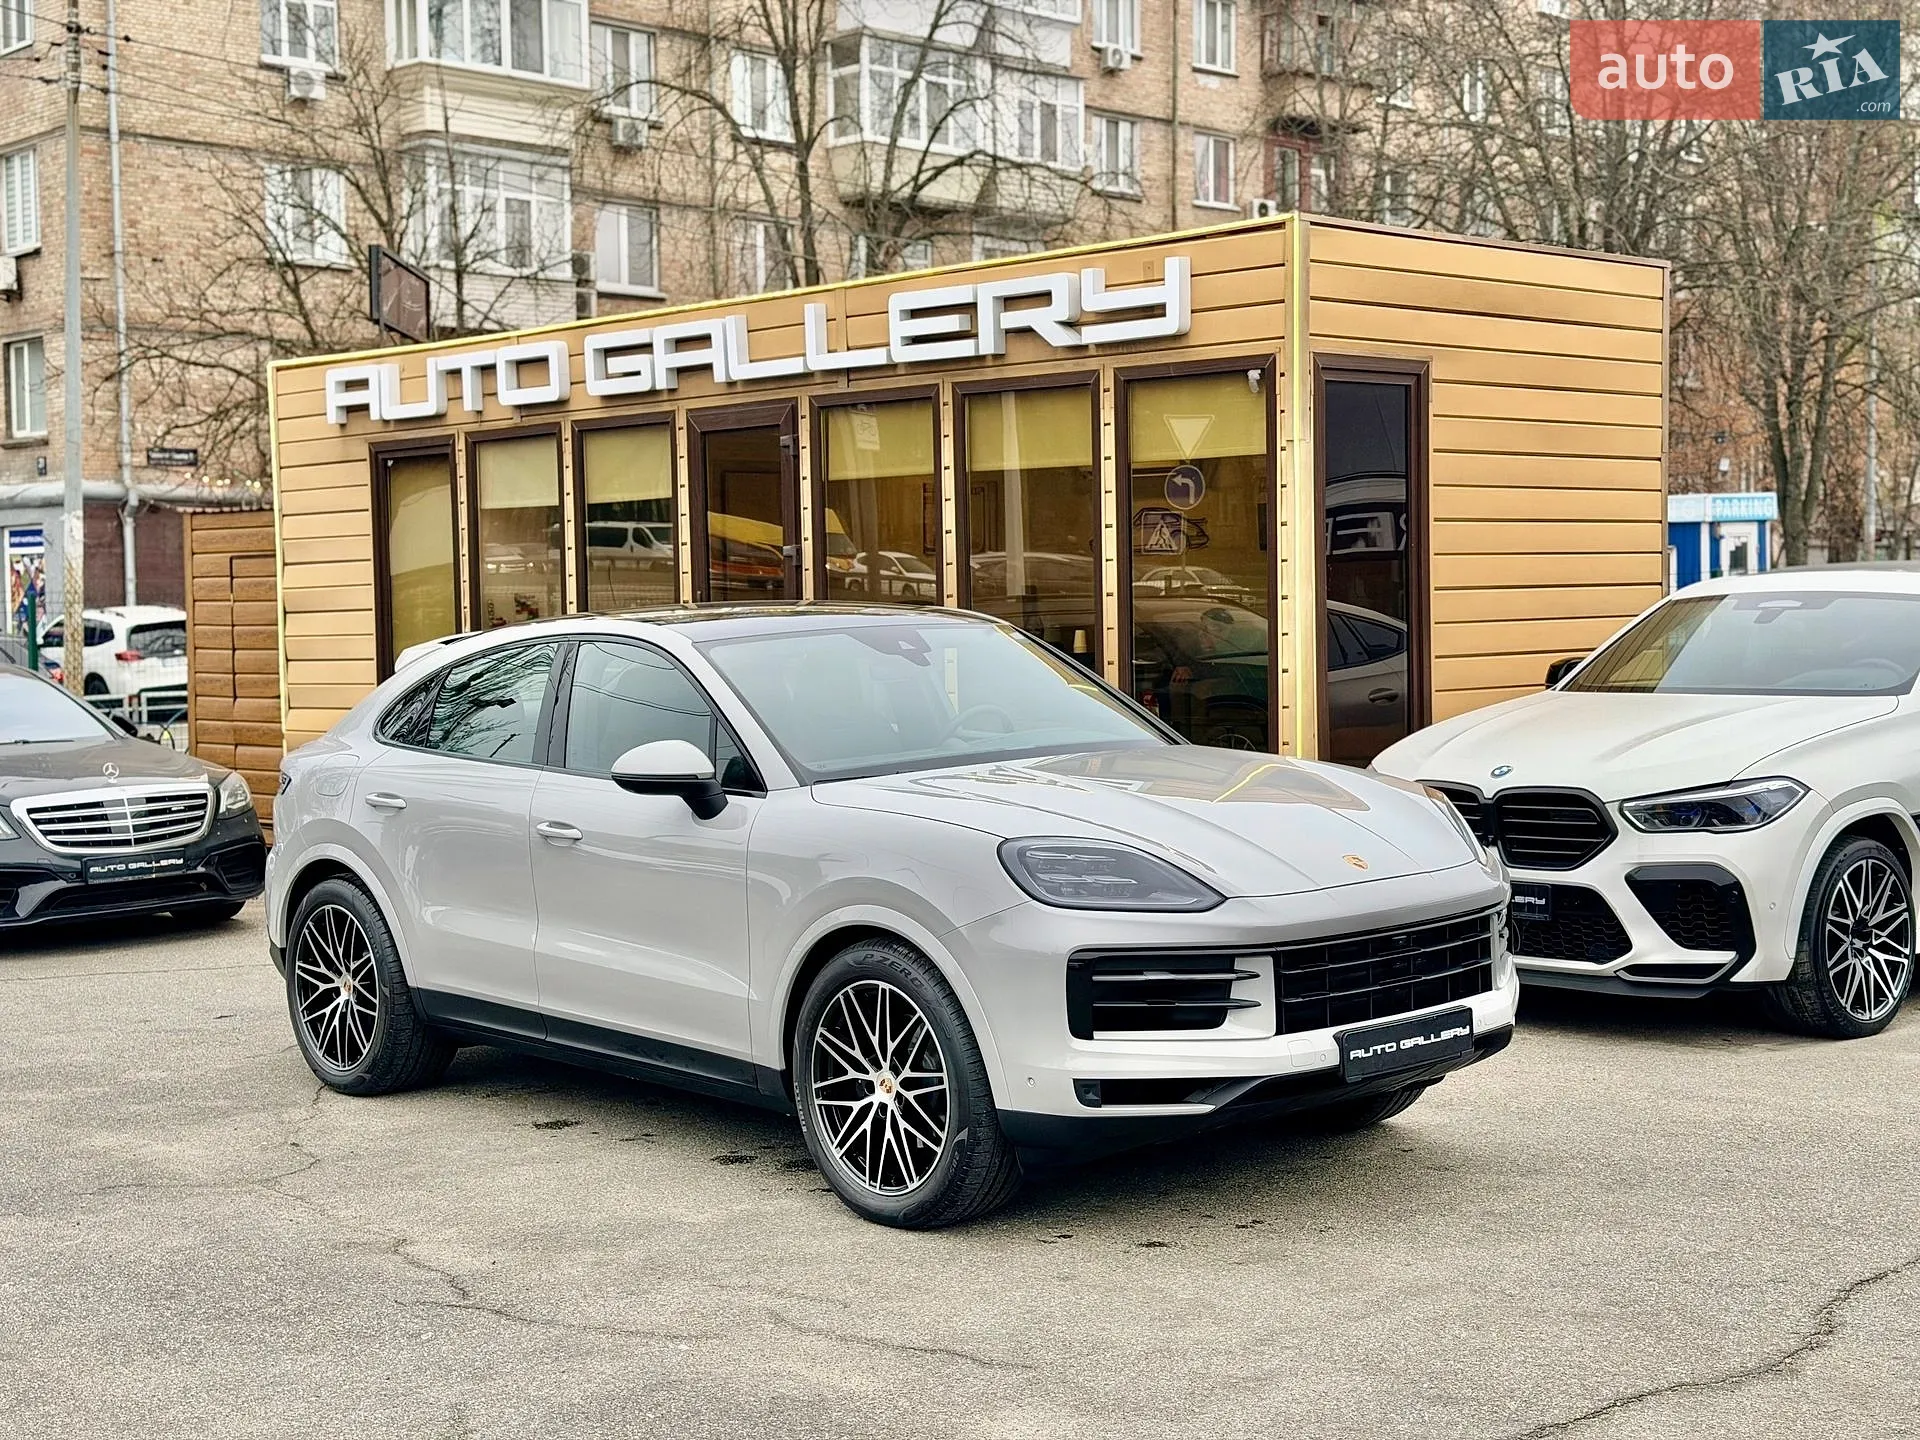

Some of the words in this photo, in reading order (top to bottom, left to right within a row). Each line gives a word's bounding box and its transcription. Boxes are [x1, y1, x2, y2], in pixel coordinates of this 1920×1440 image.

[325, 340, 571, 425] AUTO
[584, 256, 1191, 397] GALLERY
[1715, 498, 1773, 518] PARKING
[89, 863, 126, 873] AUTO
[128, 857, 184, 869] GALLERY
[1511, 895, 1546, 905] ERY
[862, 953, 874, 961] P
[879, 955, 925, 989] ZERO
[1349, 1042, 1397, 1061] AUTO
[1399, 1025, 1470, 1050] GALLERY
